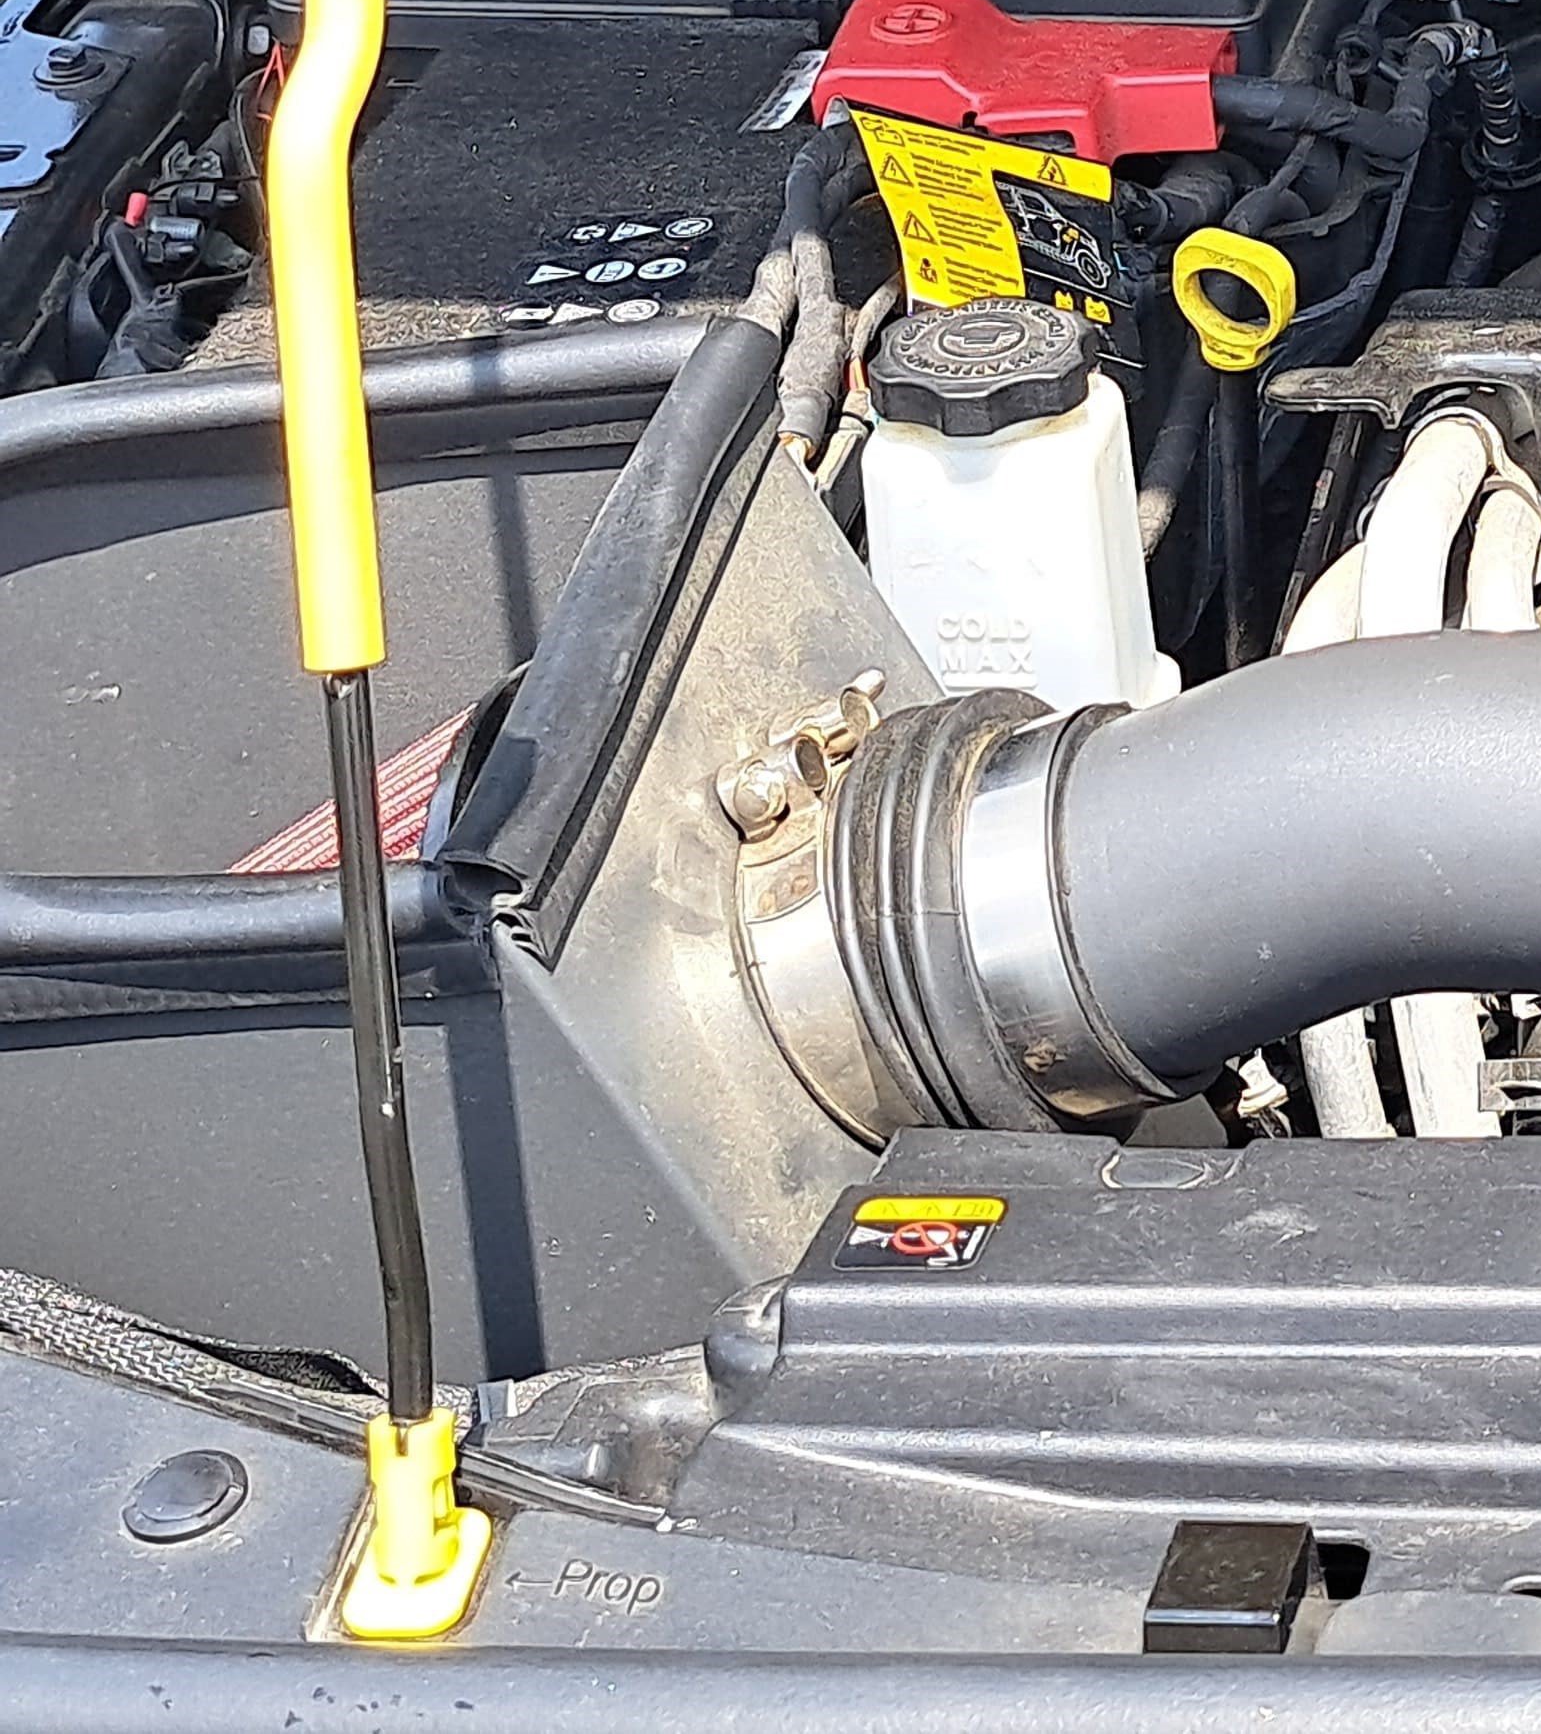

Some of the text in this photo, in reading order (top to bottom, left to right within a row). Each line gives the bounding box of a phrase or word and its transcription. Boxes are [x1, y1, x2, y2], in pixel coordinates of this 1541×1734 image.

[937, 612, 1032, 643] COLD
[938, 643, 1034, 673] MAX
[553, 1558, 662, 1616] Prop
